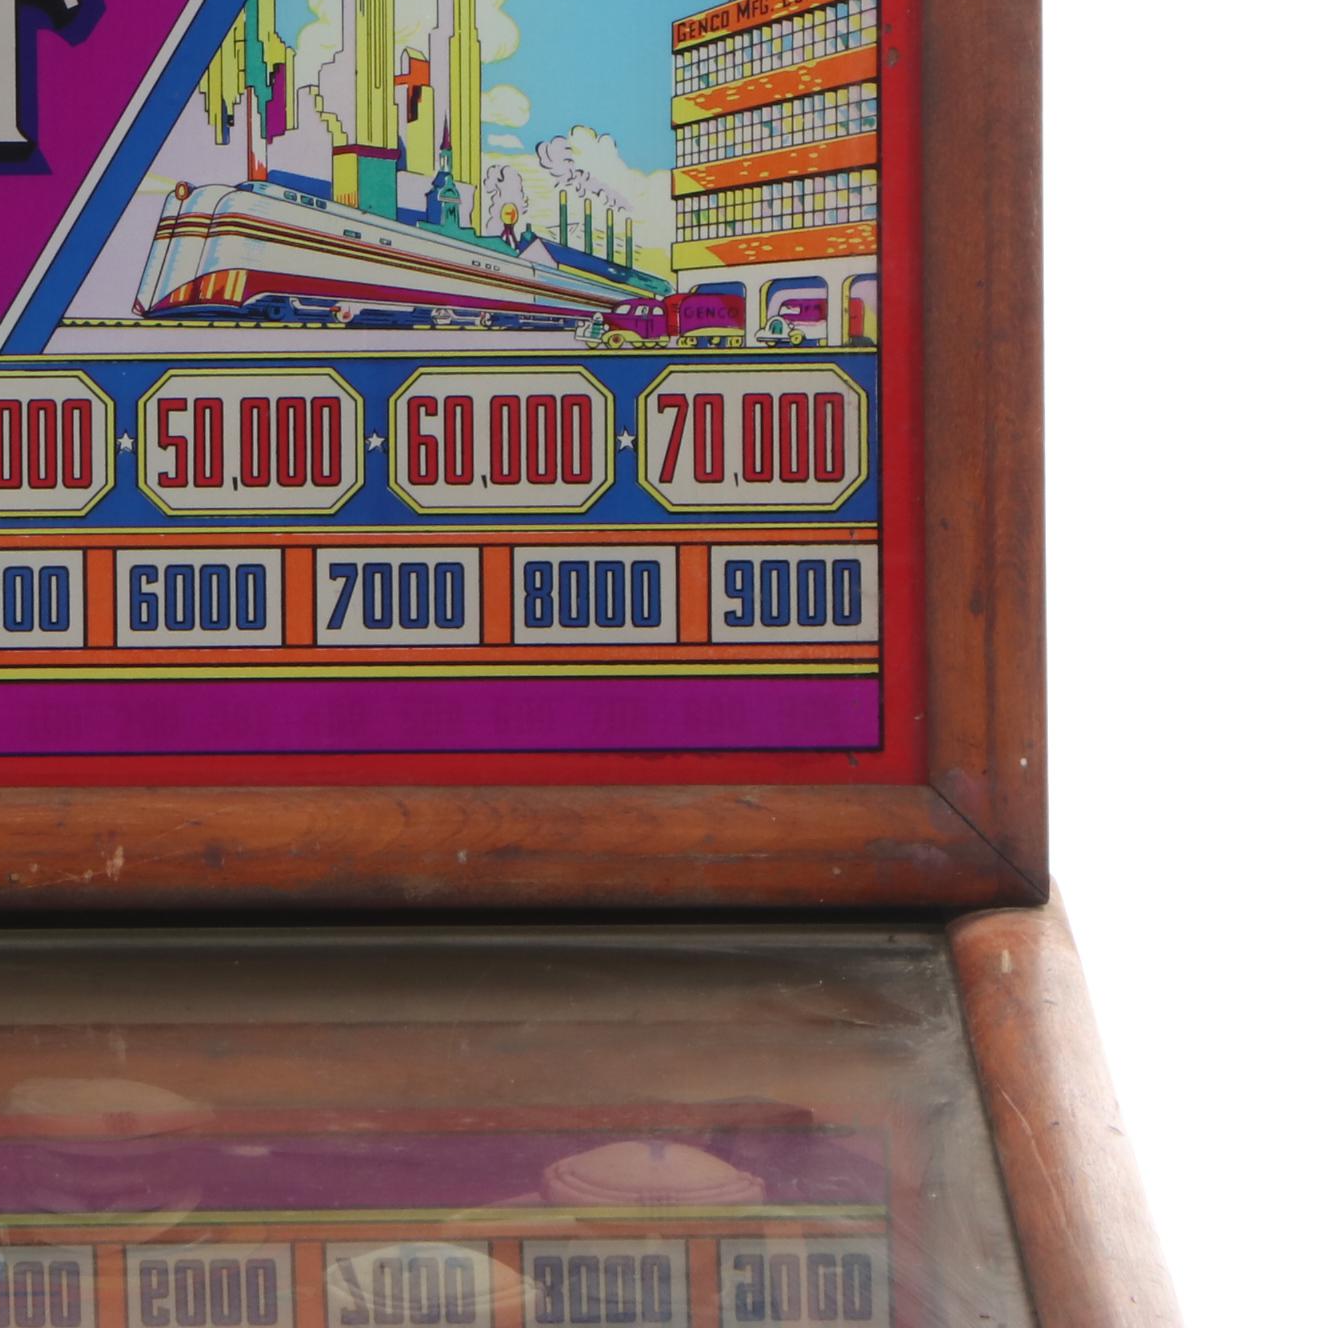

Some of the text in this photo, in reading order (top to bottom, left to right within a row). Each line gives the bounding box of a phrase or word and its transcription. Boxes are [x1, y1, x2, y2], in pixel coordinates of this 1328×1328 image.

[676, 11, 730, 43] GENCO
[683, 305, 739, 320] GENCO
[157, 396, 342, 490] 50,000
[407, 394, 593, 488] 60,000
[657, 392, 845, 487] 70,000
[129, 563, 267, 632] 6000
[326, 562, 465, 630] 7000
[524, 560, 662, 628] 8000
[724, 559, 862, 627] 9000
